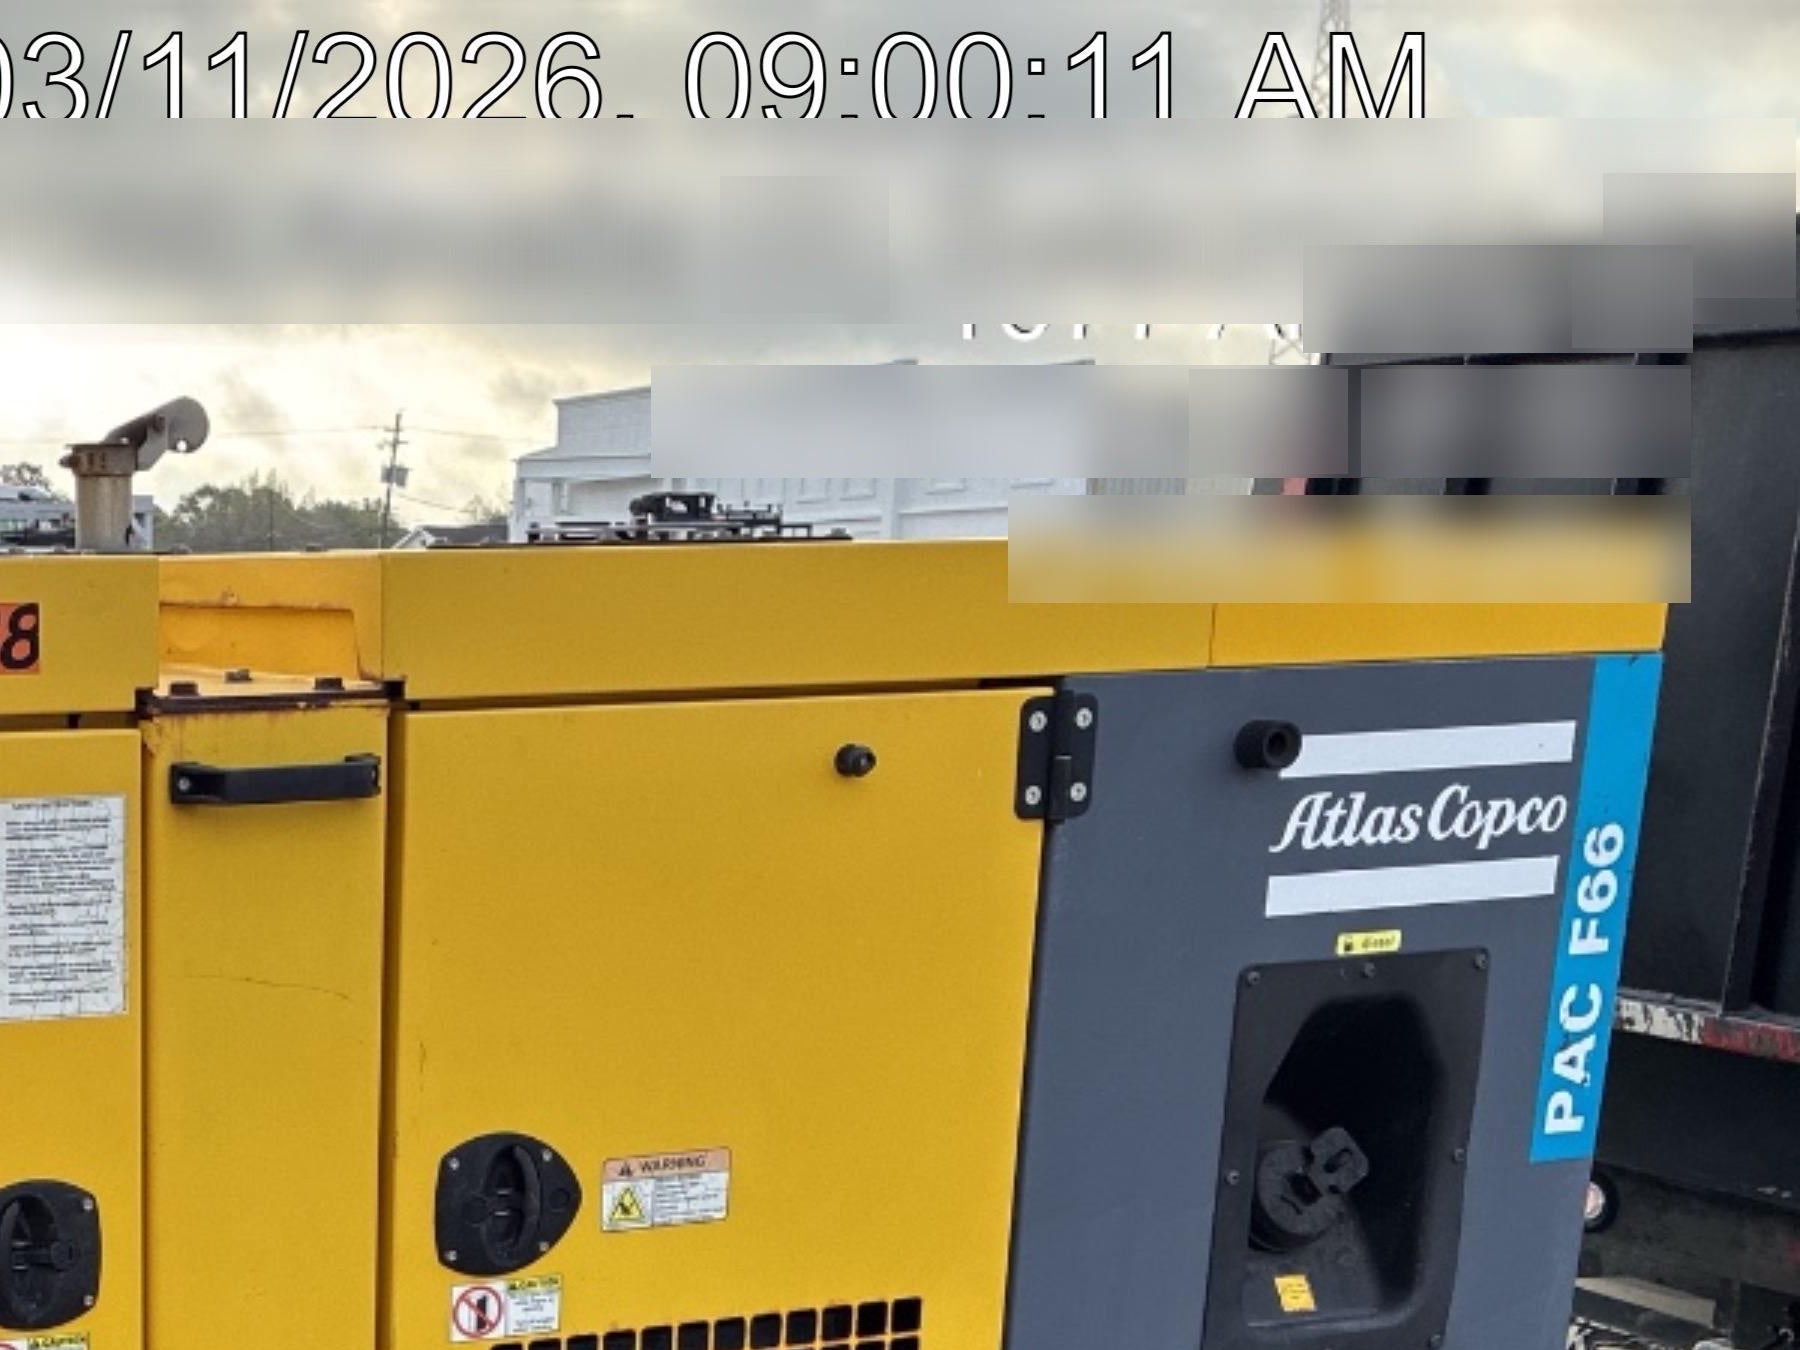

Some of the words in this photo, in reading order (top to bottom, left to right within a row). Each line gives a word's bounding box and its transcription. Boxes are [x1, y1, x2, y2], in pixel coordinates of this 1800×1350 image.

[1268, 790, 1423, 853] Atlas
[1427, 783, 1568, 851] Copco
[1568, 821, 1626, 956] F66
[1543, 981, 1602, 1135] PAC
